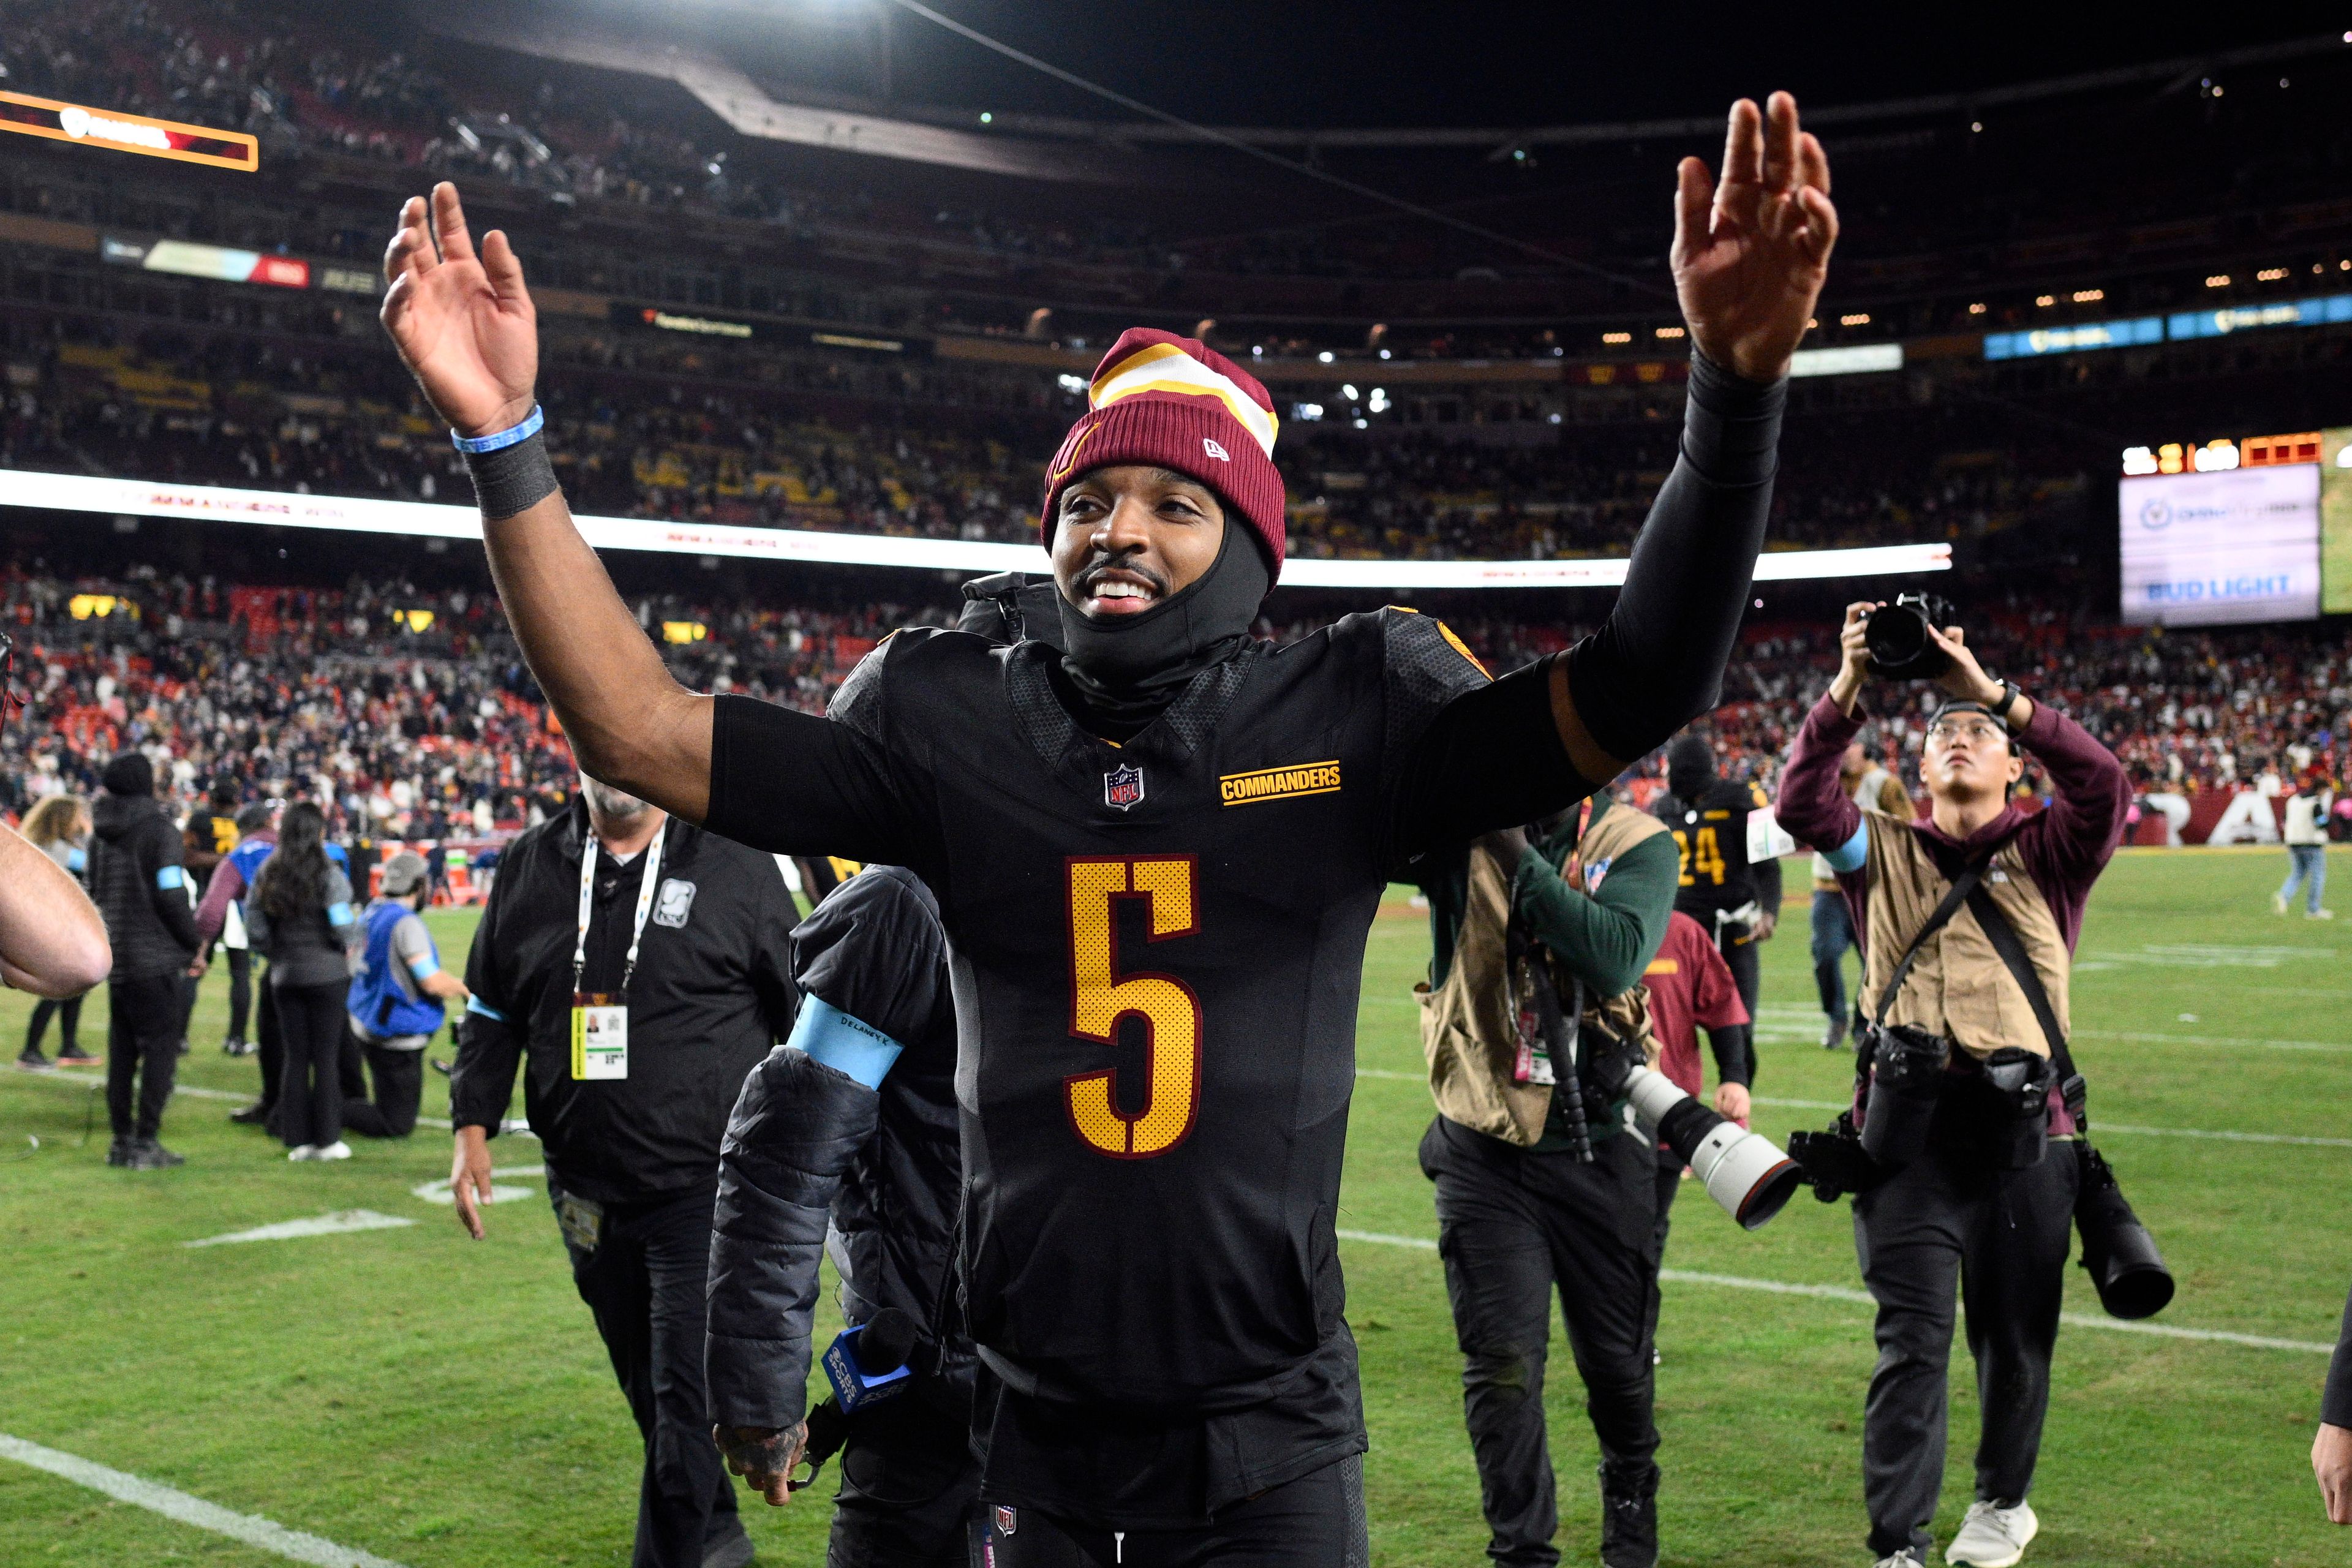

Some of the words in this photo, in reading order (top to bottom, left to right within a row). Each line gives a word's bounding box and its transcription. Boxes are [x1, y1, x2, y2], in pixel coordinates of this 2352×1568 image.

[2146, 581, 2204, 601] BUD
[2210, 575, 2291, 599] LIGHT
[1110, 783, 1138, 804] NFL
[1221, 766, 1341, 801] COMMANDERS
[1063, 853, 1203, 1159] 5
[840, 1016, 881, 1042] DELANEY
[828, 1354, 852, 1404] SPORTS
[839, 1362, 857, 1398] CBS
[998, 1508, 1014, 1529] NFL
